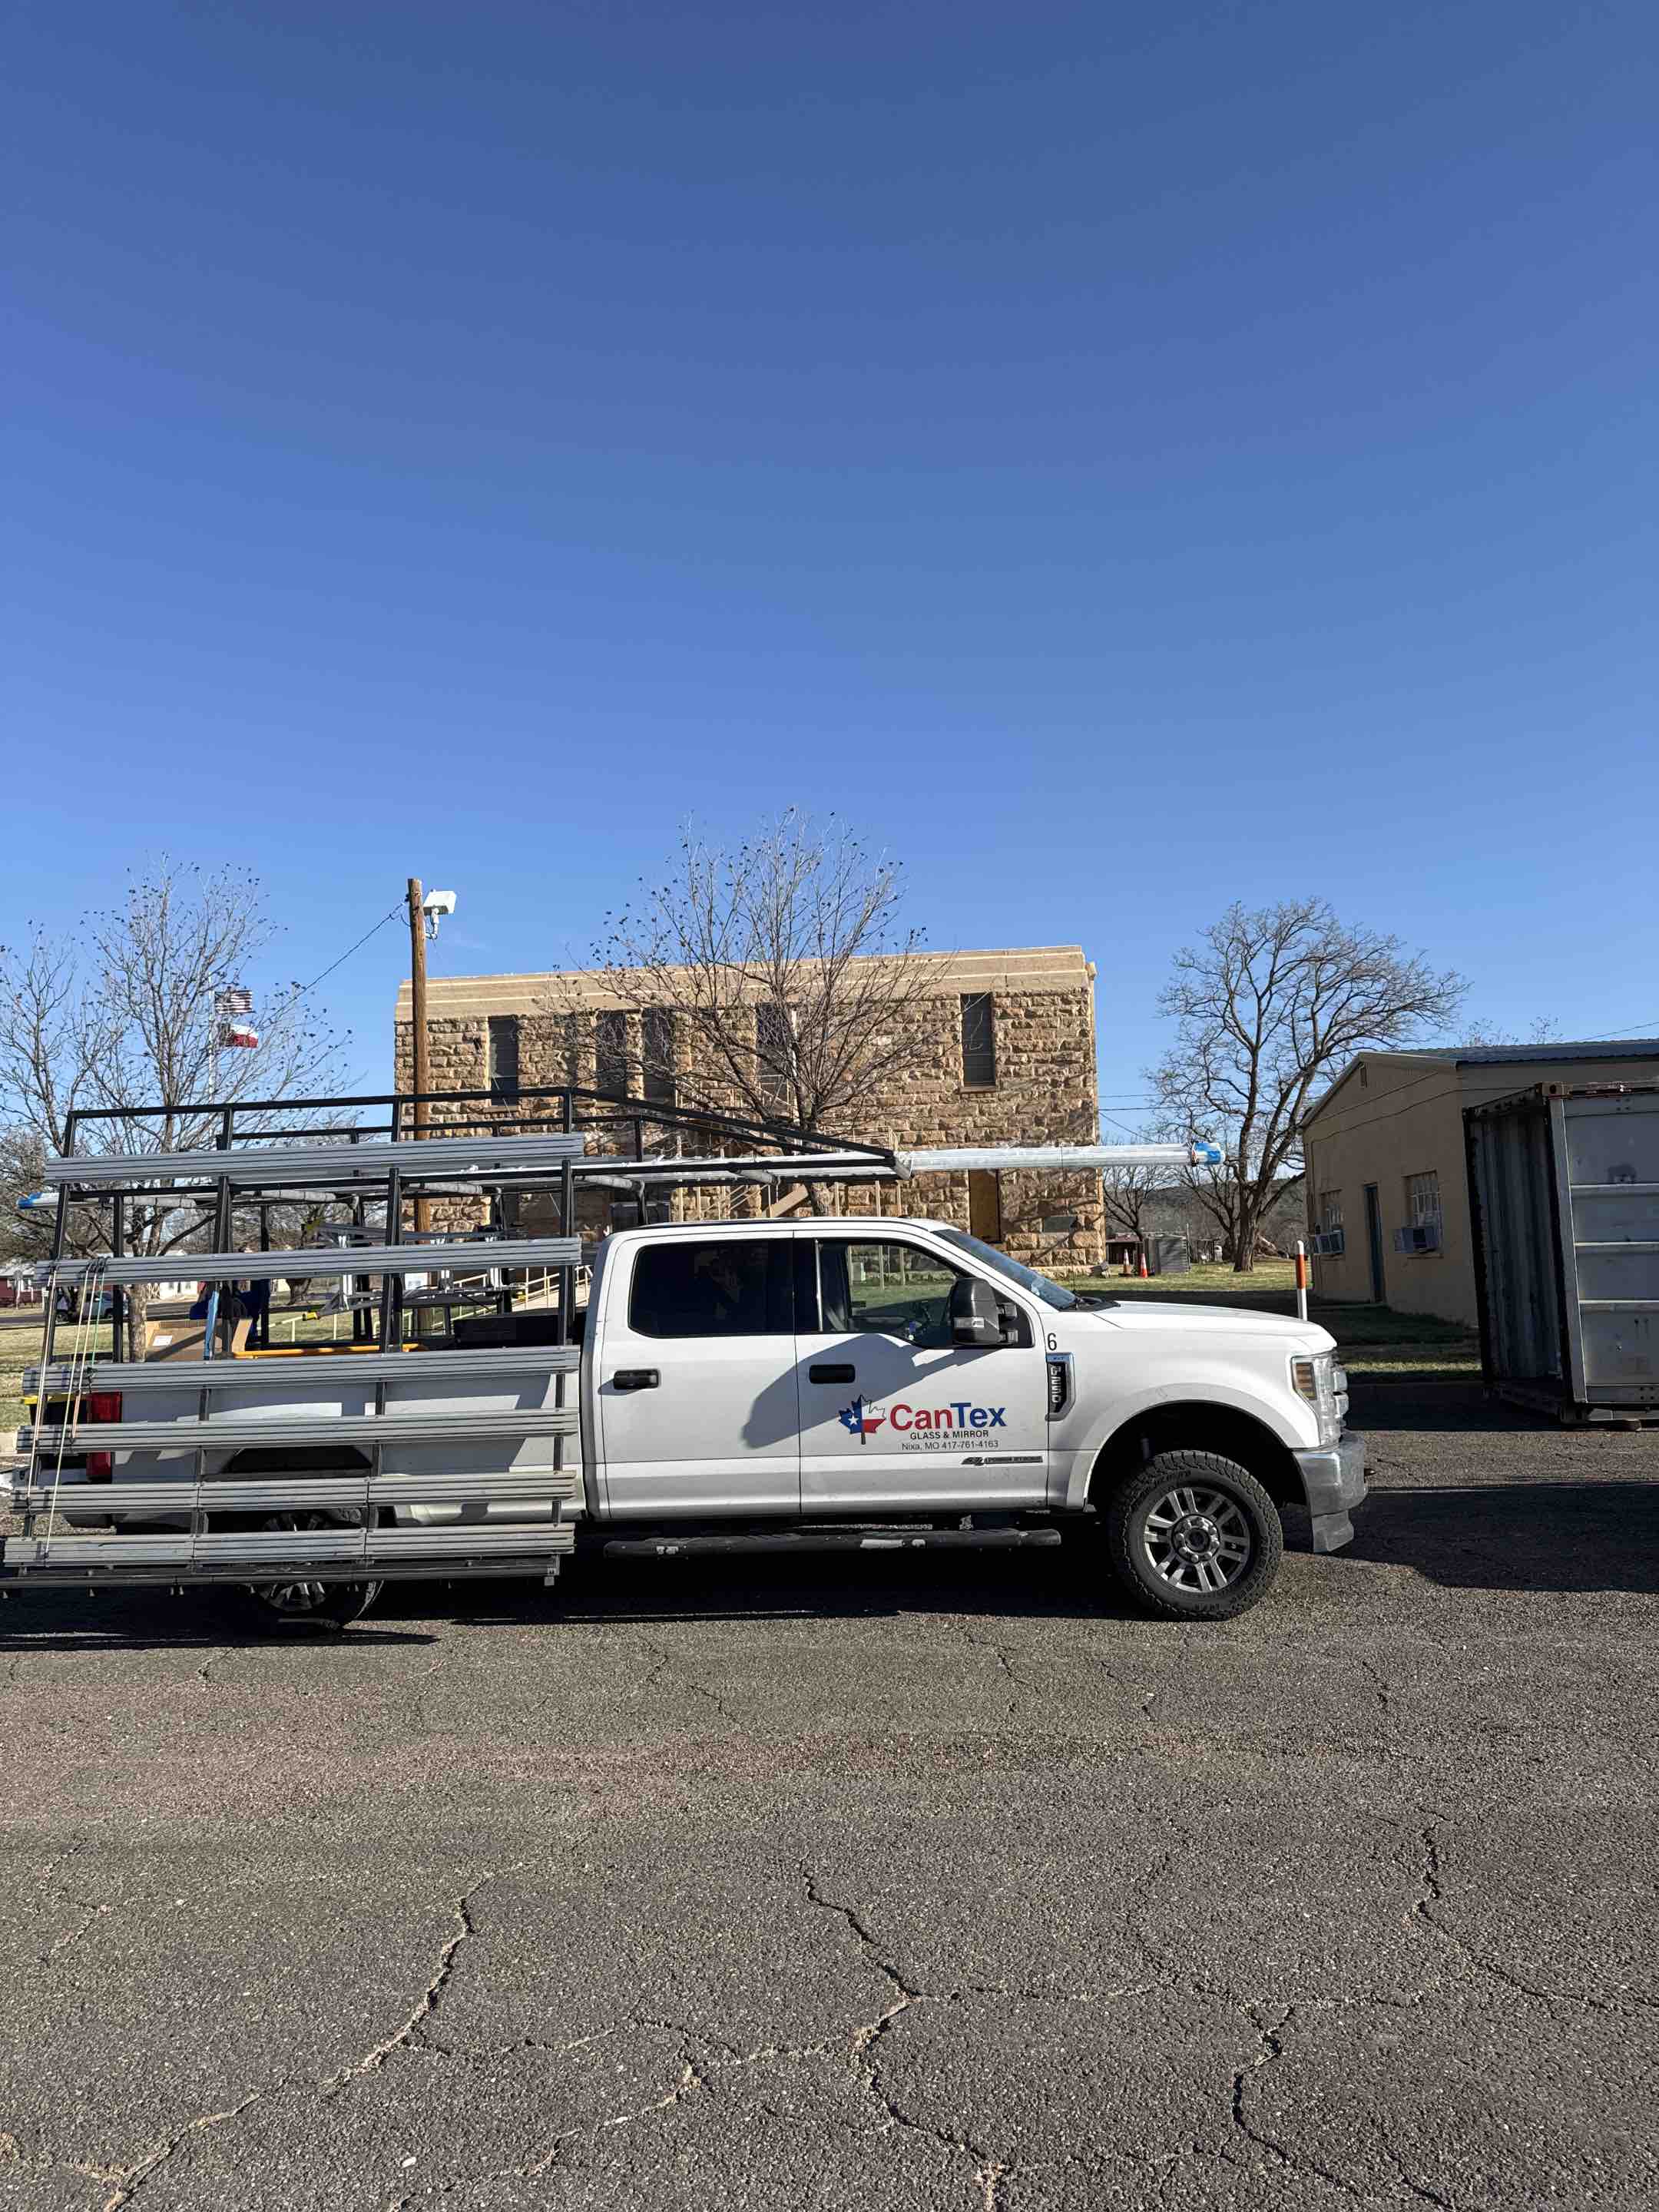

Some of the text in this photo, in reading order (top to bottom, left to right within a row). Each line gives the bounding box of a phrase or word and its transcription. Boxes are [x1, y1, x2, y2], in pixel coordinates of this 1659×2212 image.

[1047, 1333, 1057, 1351] 6
[889, 1402, 1007, 1431] CanTex
[910, 1431, 941, 1440] GLASS
[952, 1429, 988, 1439] MIRROR
[925, 1442, 940, 1450] MO
[942, 1440, 998, 1449] 417-761-4163
